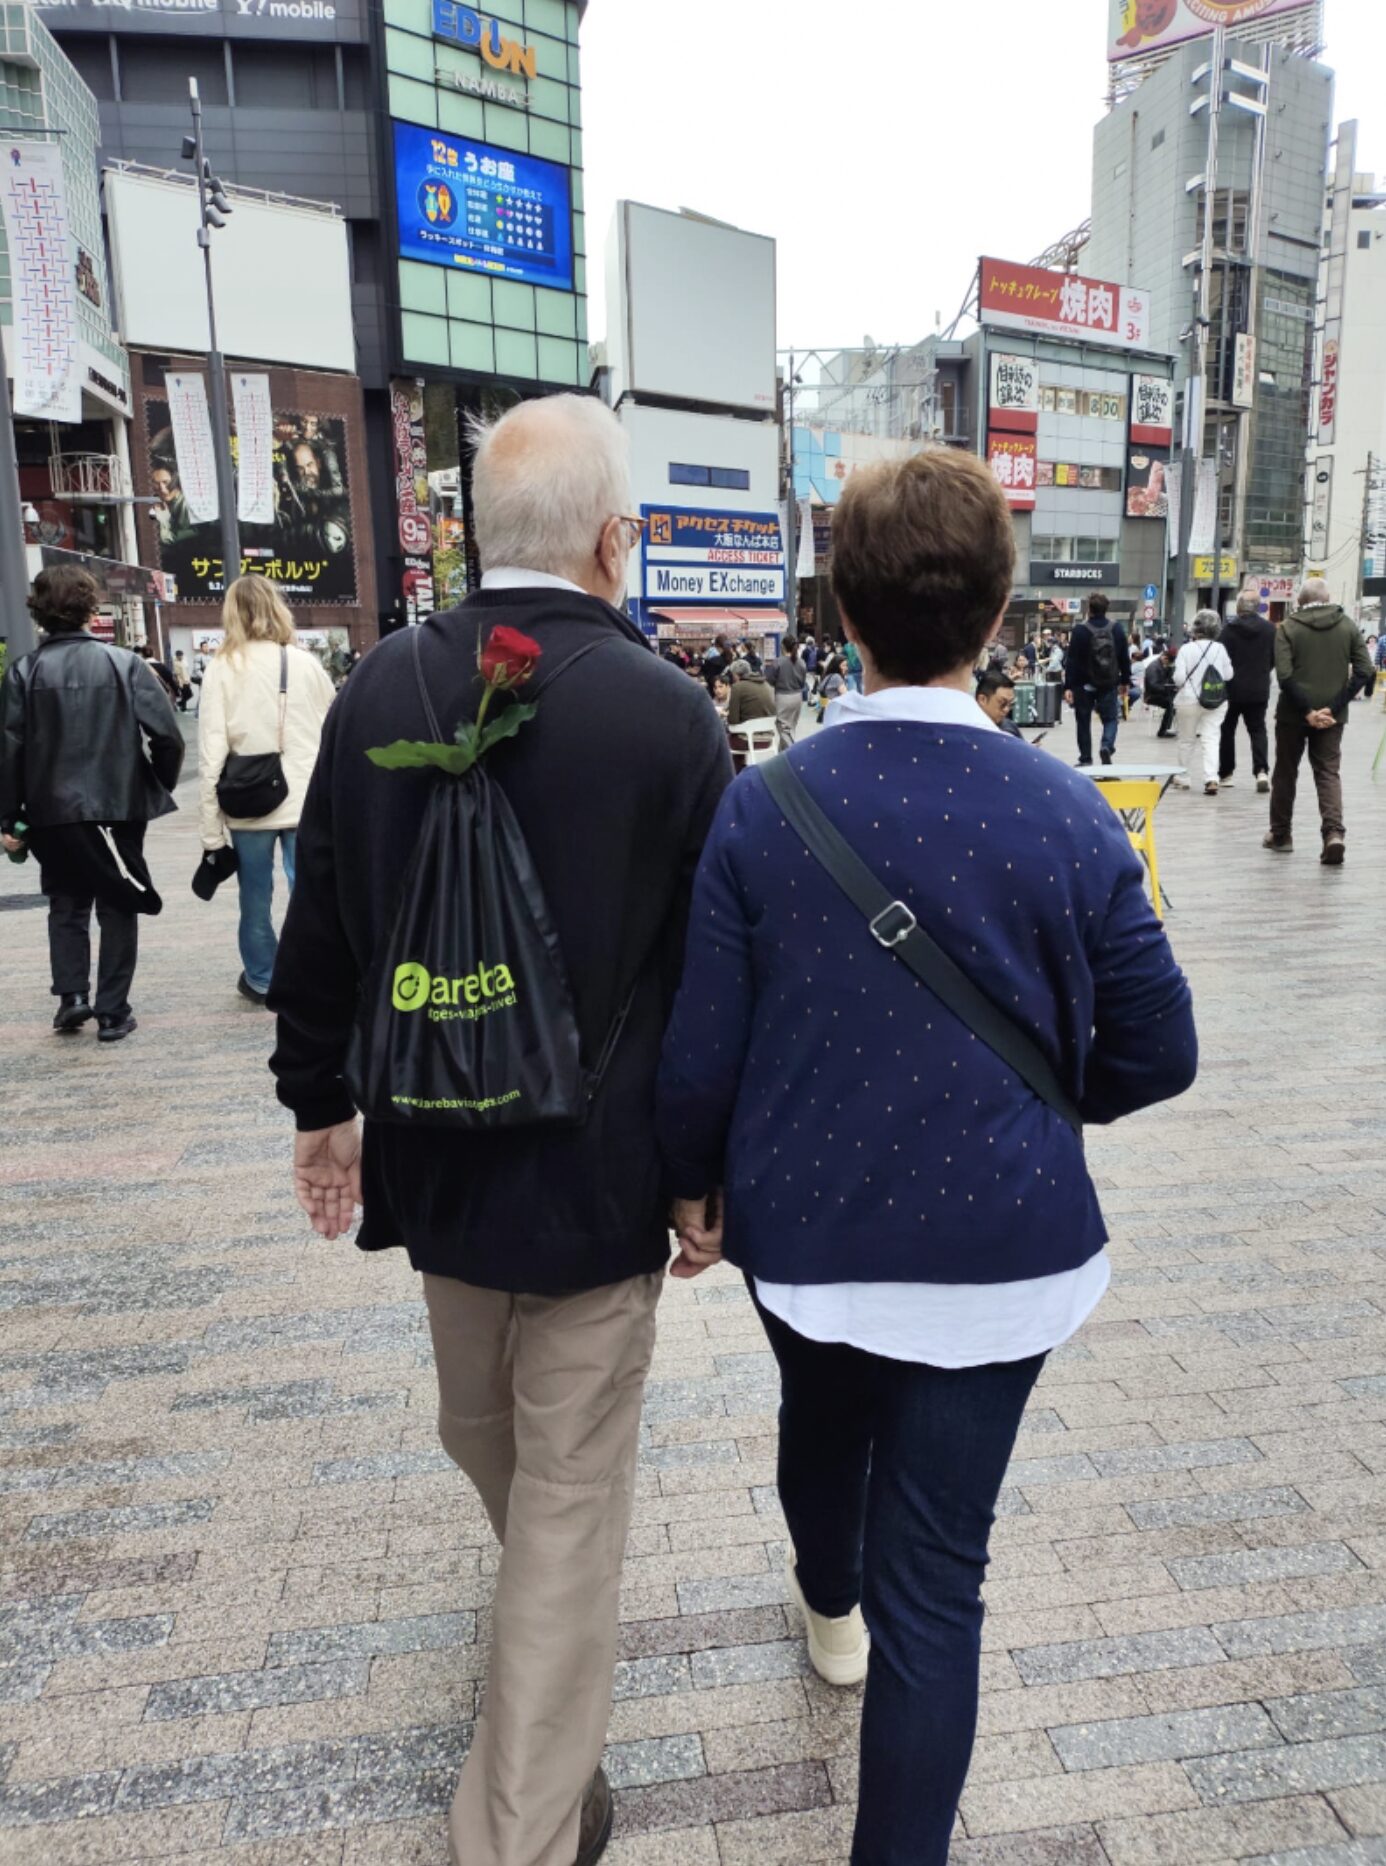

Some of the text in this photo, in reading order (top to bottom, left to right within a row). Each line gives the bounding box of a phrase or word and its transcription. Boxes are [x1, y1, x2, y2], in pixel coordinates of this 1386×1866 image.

[270, 2, 336, 20] mobile
[454, 72, 518, 104] NAMBA
[1059, 277, 1113, 329] 焼肉
[1321, 353, 1338, 426] ジャンカラ
[991, 450, 1035, 487] 焼肉
[707, 549, 780, 563] ACCESS TICKET
[656, 569, 775, 596] Money EXchange
[1053, 567, 1103, 579] STARBUCKS
[431, 960, 515, 1005] areba
